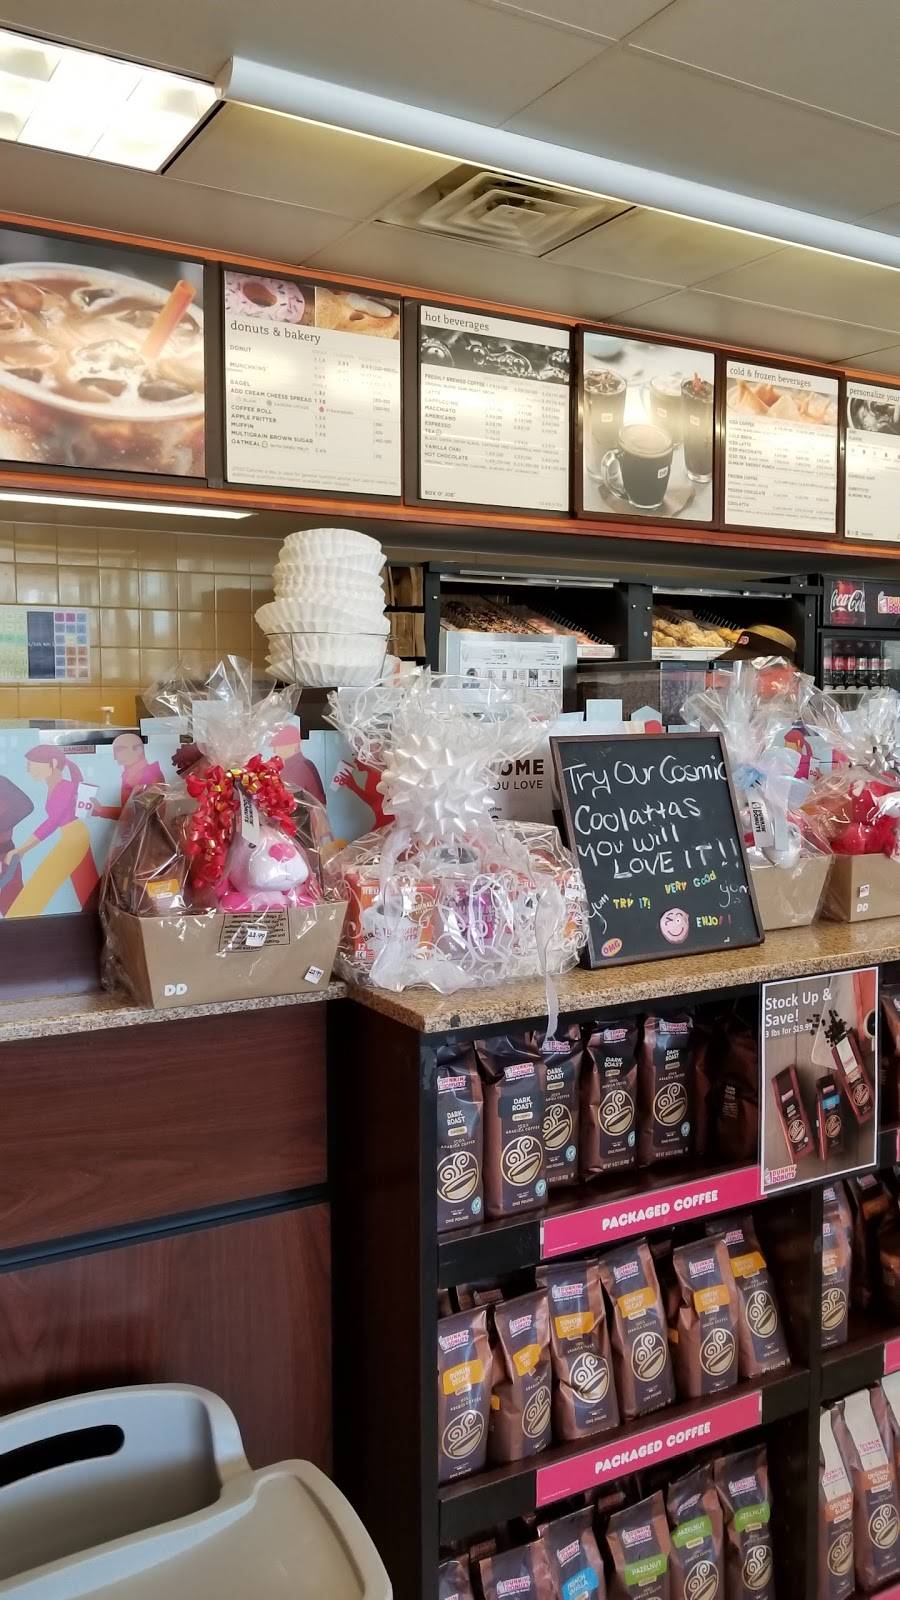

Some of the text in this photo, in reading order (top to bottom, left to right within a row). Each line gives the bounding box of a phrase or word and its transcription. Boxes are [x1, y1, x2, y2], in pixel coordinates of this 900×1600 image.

[425, 311, 490, 332] hot beverages
[230, 320, 321, 344] donuts & bakery
[230, 345, 251, 353] DONUT
[230, 379, 251, 387] BAGEL
[729, 367, 811, 388] cold & frozen beverages
[245, 390, 265, 398] CREAM
[266, 392, 289, 401] CHEESE
[290, 395, 312, 403] SPREAD
[849, 387, 900, 403] personalize your
[231, 404, 254, 413] COFFEE
[256, 407, 272, 415] ROLL
[425, 405, 456, 414] MACCHIATO
[231, 413, 277, 423] APPLE FRITTER
[425, 413, 456, 421] AMERICANO
[425, 421, 452, 429] ESPRESSO
[231, 430, 268, 439] MULTIGRAIN
[270, 434, 292, 442] BROWN
[231, 438, 261, 448] OATMEAL
[437, 452, 468, 461] CHOCOLATE
[563, 755, 728, 799] Try Our Cosmic
[513, 780, 543, 790] LOVE
[78, 801, 92, 810] DD
[575, 797, 701, 835] Coolattas
[576, 823, 680, 867] you will
[613, 851, 675, 879] LOVE
[664, 881, 687, 895] VERY
[613, 896, 651, 910] TRY IT!
[857, 903, 869, 912] DD
[603, 940, 621, 954] OMG
[164, 983, 188, 996] DD
[766, 987, 833, 1010] Stock Up &
[766, 1009, 799, 1027] Save!
[765, 1023, 813, 1038] 3 lbs for $19.99
[512, 1102, 533, 1111] ROAST
[513, 1096, 532, 1105] DARK
[447, 1110, 462, 1119] DARK
[447, 1117, 465, 1126] ROAST
[773, 1172, 795, 1183] DONUTS
[602, 1189, 718, 1231] PACKAGED COFFEE
[594, 1422, 711, 1474] PACKAGED COFFEE
[632, 1560, 662, 1575] HAZELNUT
